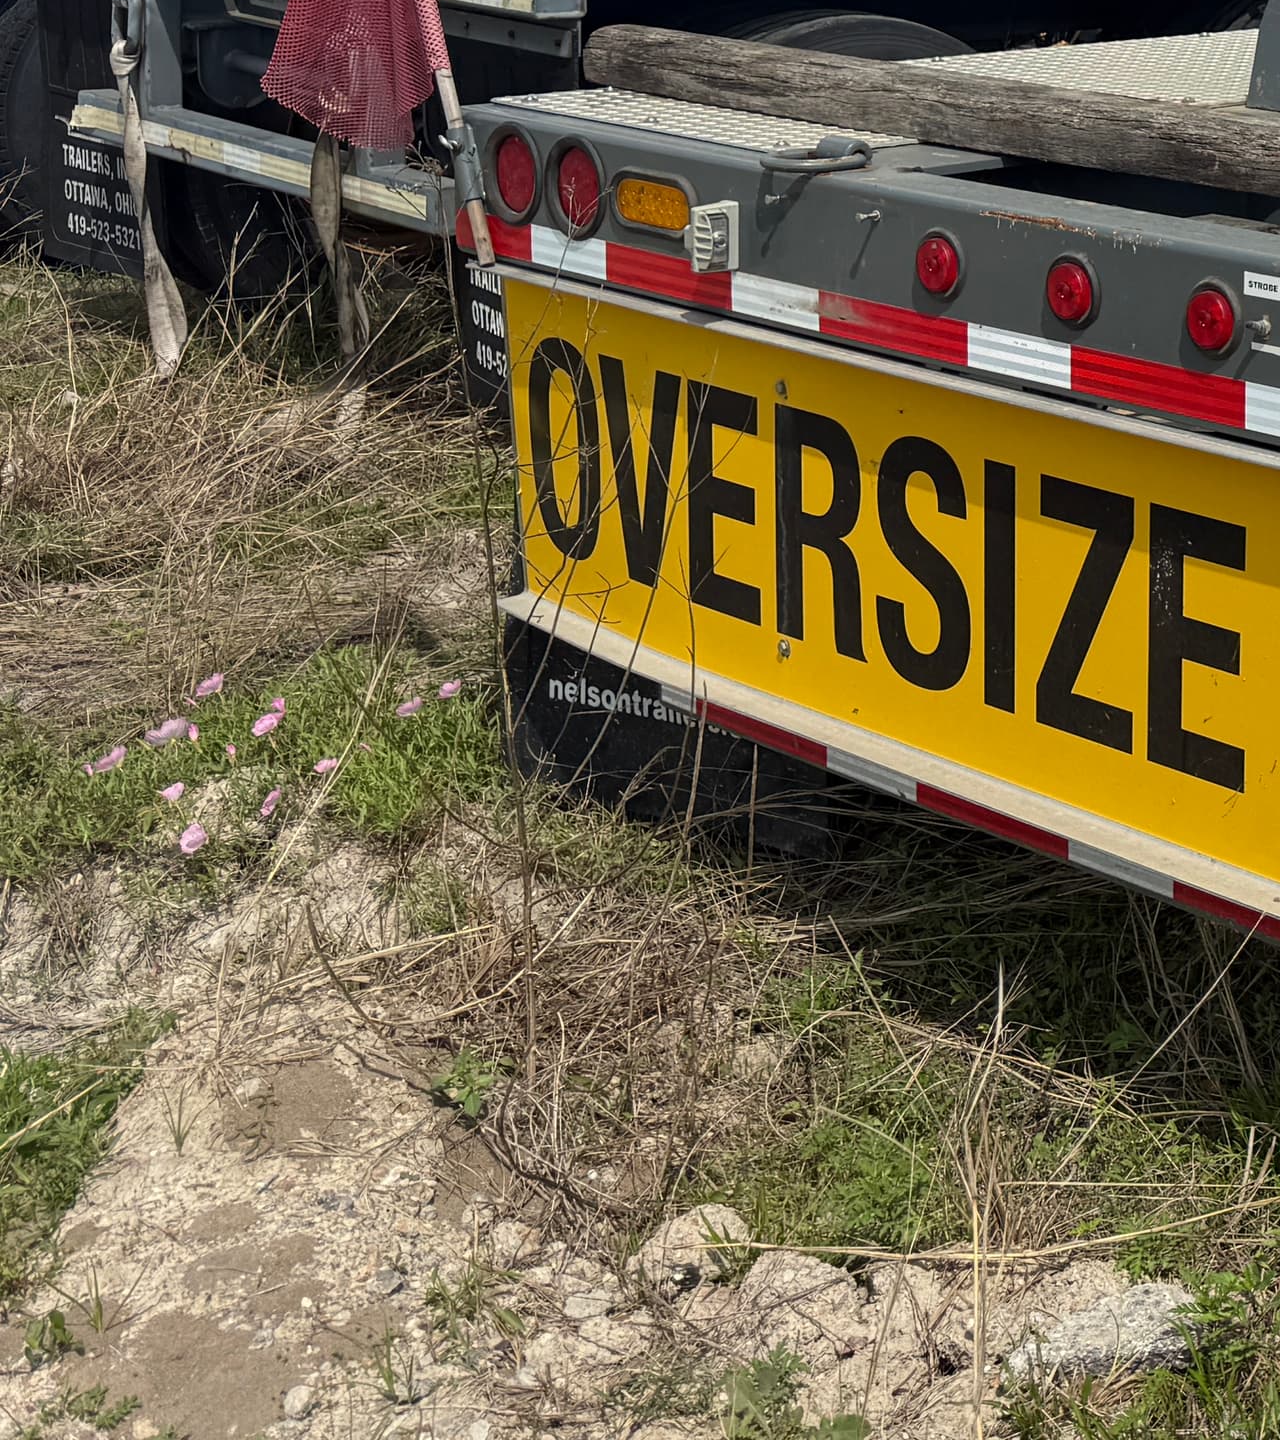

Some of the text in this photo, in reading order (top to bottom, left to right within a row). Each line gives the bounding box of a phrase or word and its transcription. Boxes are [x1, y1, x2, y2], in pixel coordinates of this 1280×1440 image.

[62, 144, 128, 180] TRAILERS, IN
[64, 179, 112, 213] OTTAWA,
[67, 212, 141, 250] 419-523-5321
[1248, 280, 1278, 292] STROBE
[471, 300, 505, 338] OTTAW
[476, 340, 507, 378] 419-52
[528, 337, 1247, 793] OVERSIZE
